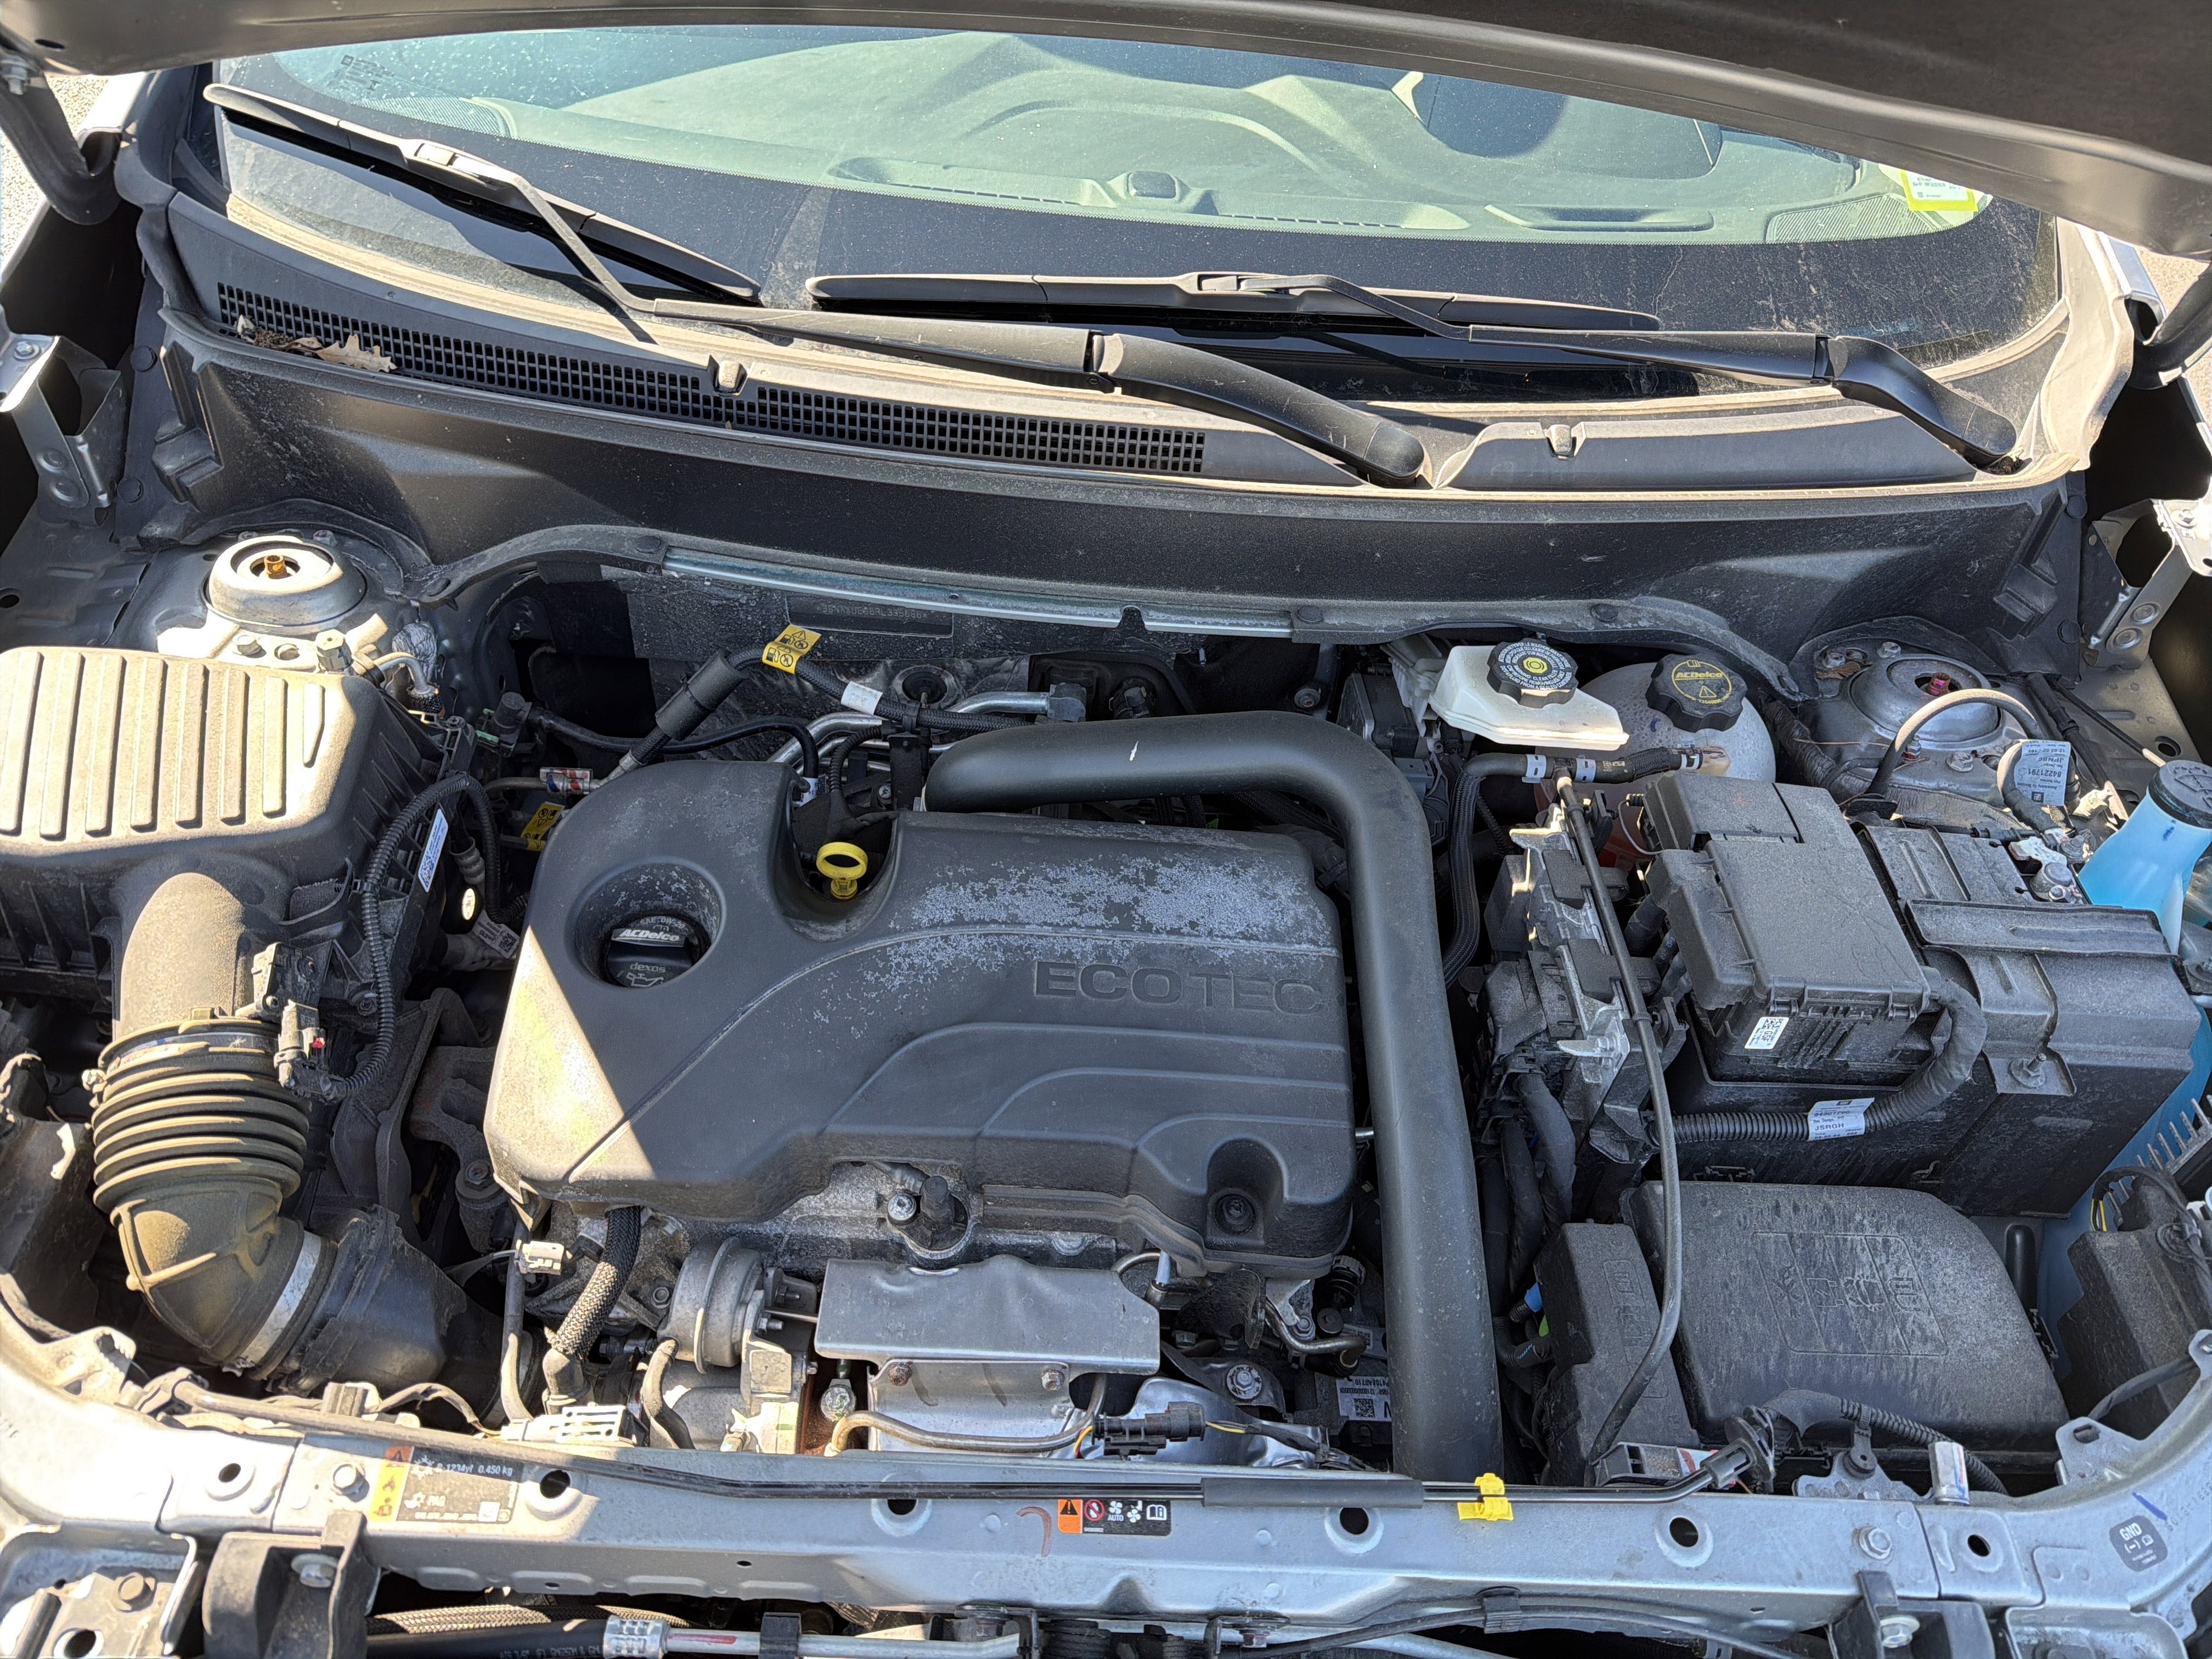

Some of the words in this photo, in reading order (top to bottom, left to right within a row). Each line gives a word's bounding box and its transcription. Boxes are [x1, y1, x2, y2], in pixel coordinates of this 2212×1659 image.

[2028, 769, 2062, 777] 84221791
[640, 917, 656, 926] SAE
[660, 917, 685, 929] 0W-20
[619, 929, 680, 941] ACDelco
[629, 962, 666, 973] dexos
[1034, 960, 1323, 1015] ECOTEC
[478, 1466, 500, 1475] 0.450
[502, 1466, 513, 1476] kg
[2119, 1522, 2142, 1541] GND
